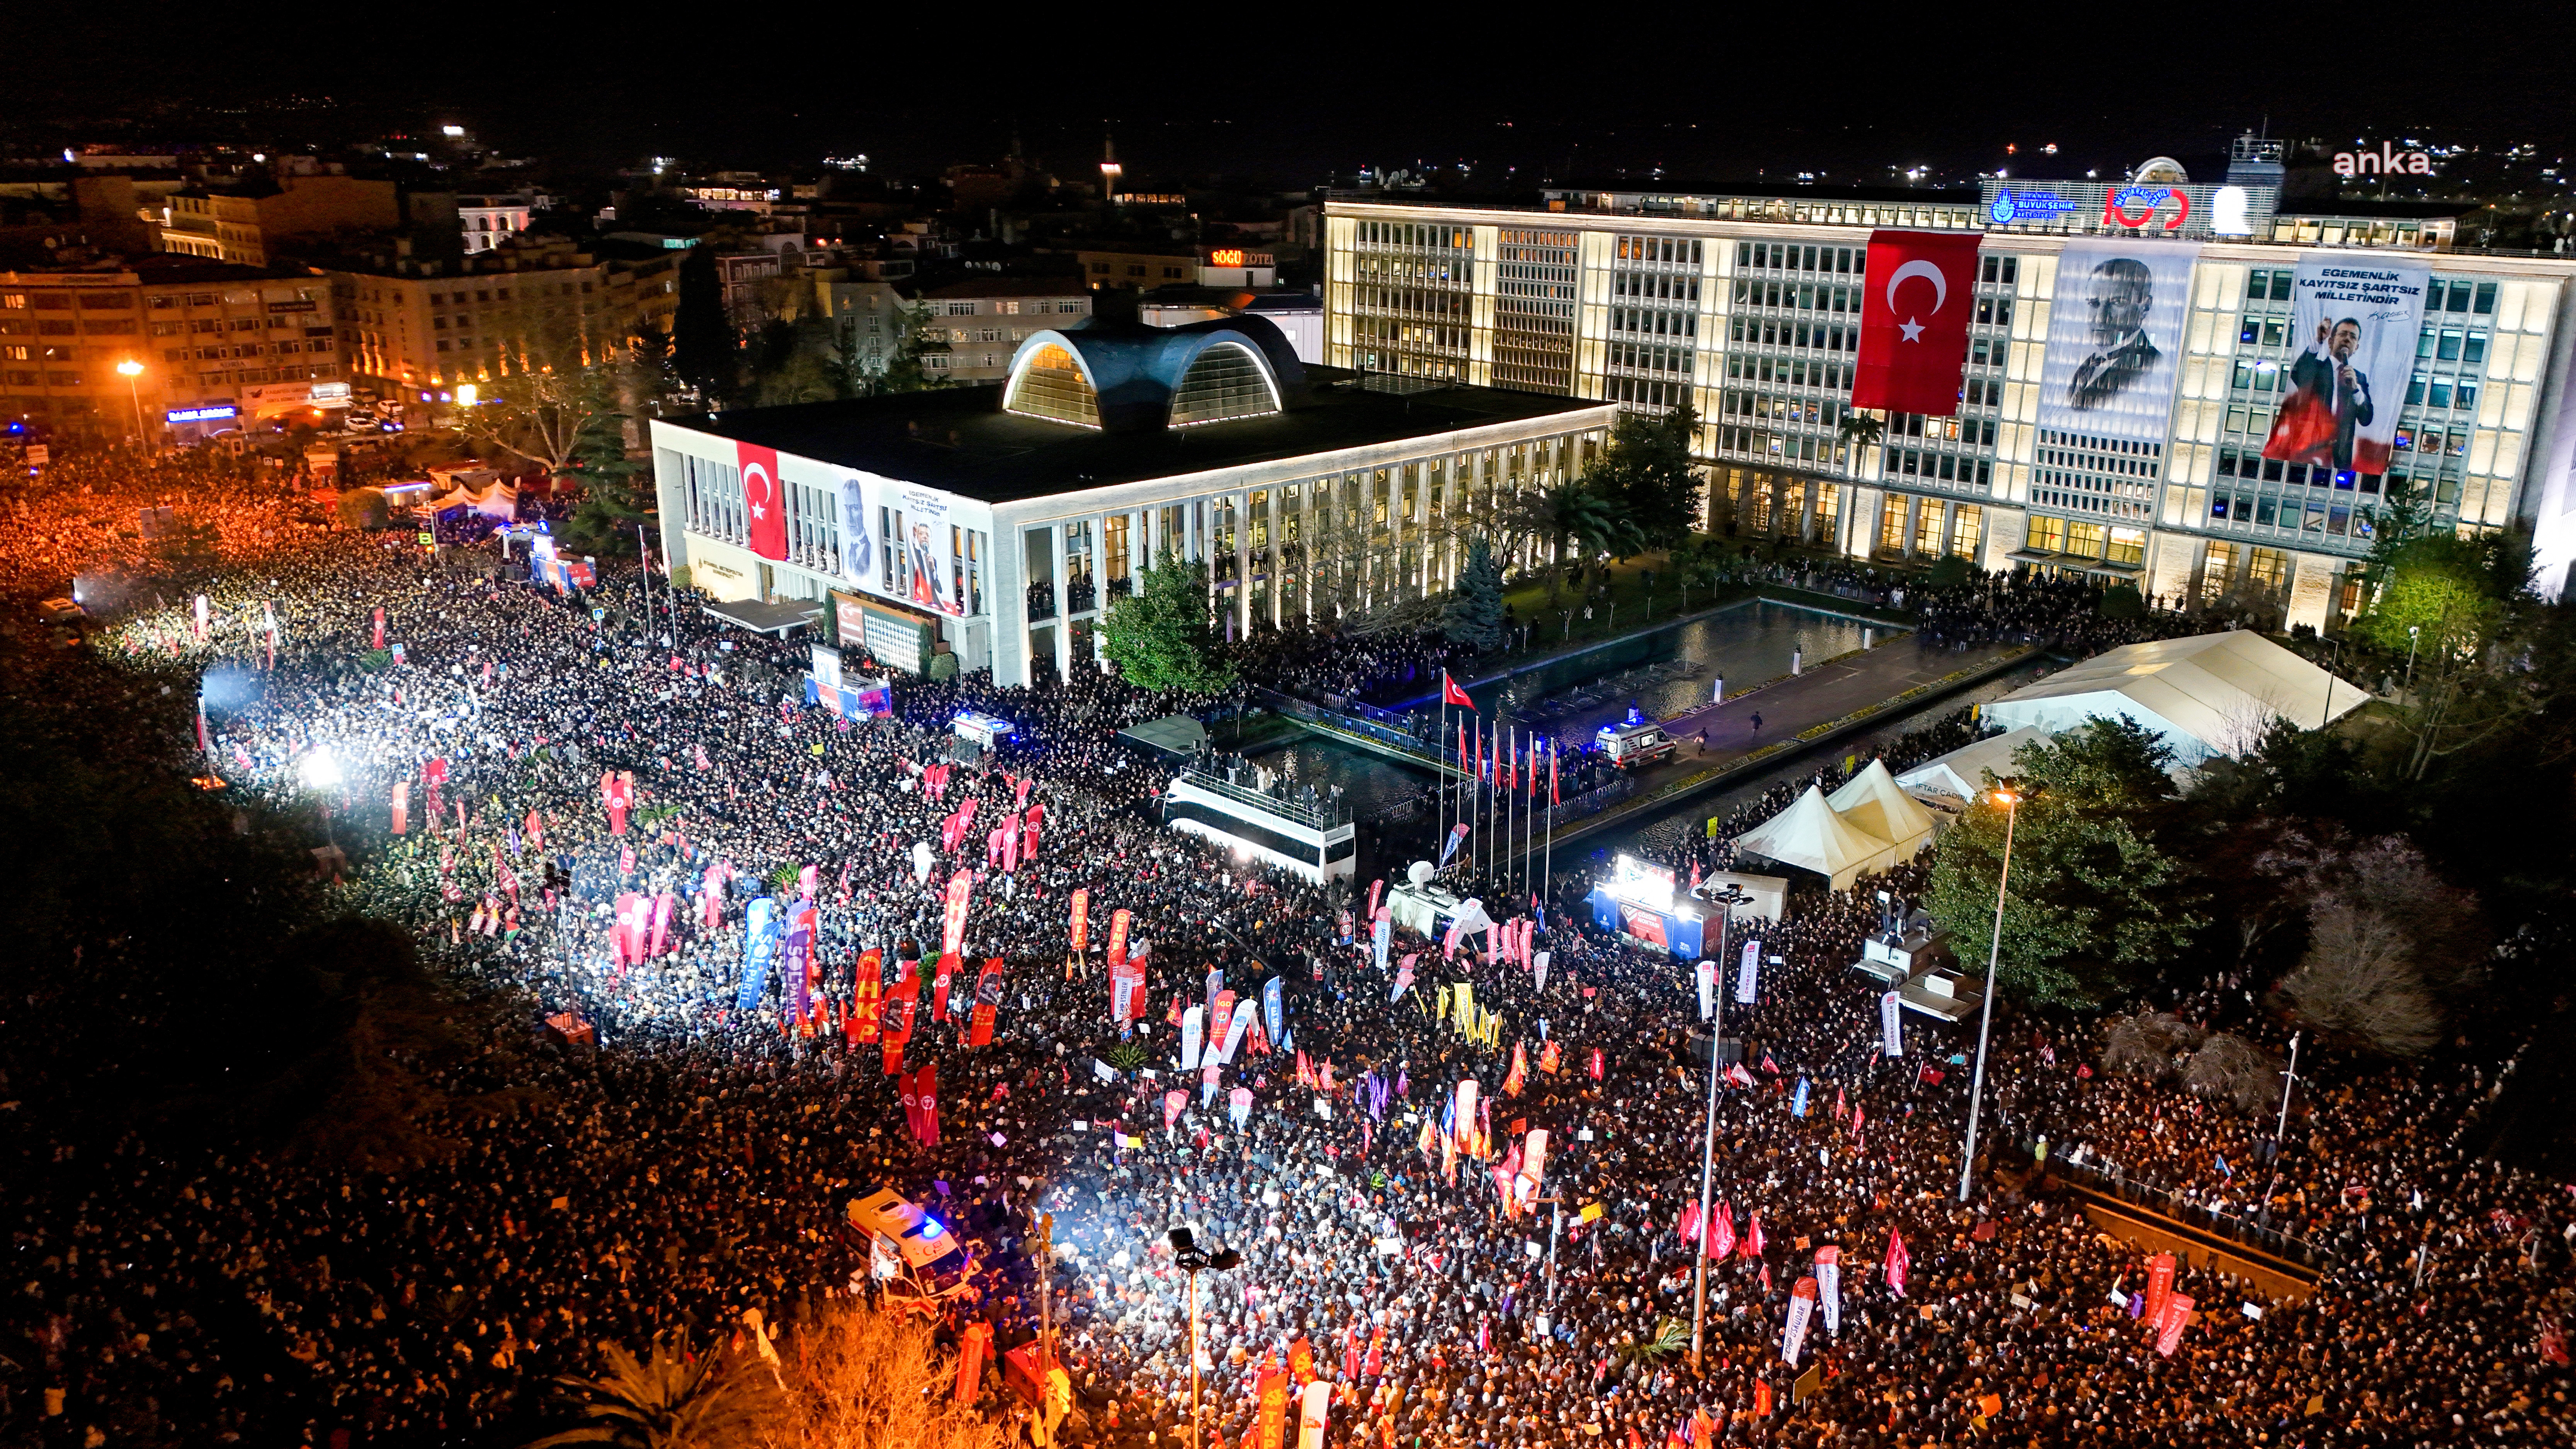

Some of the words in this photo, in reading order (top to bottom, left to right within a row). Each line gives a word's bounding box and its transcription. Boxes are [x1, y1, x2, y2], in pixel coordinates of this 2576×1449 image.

[2018, 200, 2074, 210] BÜYÜKŞEHİR
[1250, 253, 1274, 264] OTEL
[2321, 269, 2399, 281] EGEMENLİK
[2299, 279, 2359, 289] KAYITSIZ
[2361, 282, 2420, 295] ŞARTSIZ
[2314, 290, 2399, 304] MİLLETİNDİR
[908, 490, 939, 502] EGEMENLİK
[1916, 781, 1938, 794] İFTAR
[1940, 789, 1967, 803] ÇADIRI
[1074, 905, 1084, 943] EMEK
[1637, 912, 1657, 922] ÇÖZÜM
[1637, 918, 1660, 928] NOKTASI
[1110, 924, 1123, 953] EME
[749, 933, 773, 967] SOL
[787, 946, 803, 981] SOL
[857, 981, 879, 1042] HKP
[1124, 1019, 1130, 1028] 30
[1270, 1007, 1280, 1040] ESP
[2173, 1303, 2189, 1311] CHP
[1792, 1305, 1806, 1338] ÜSKÜDAR
[1785, 1338, 1794, 1354] CHP
